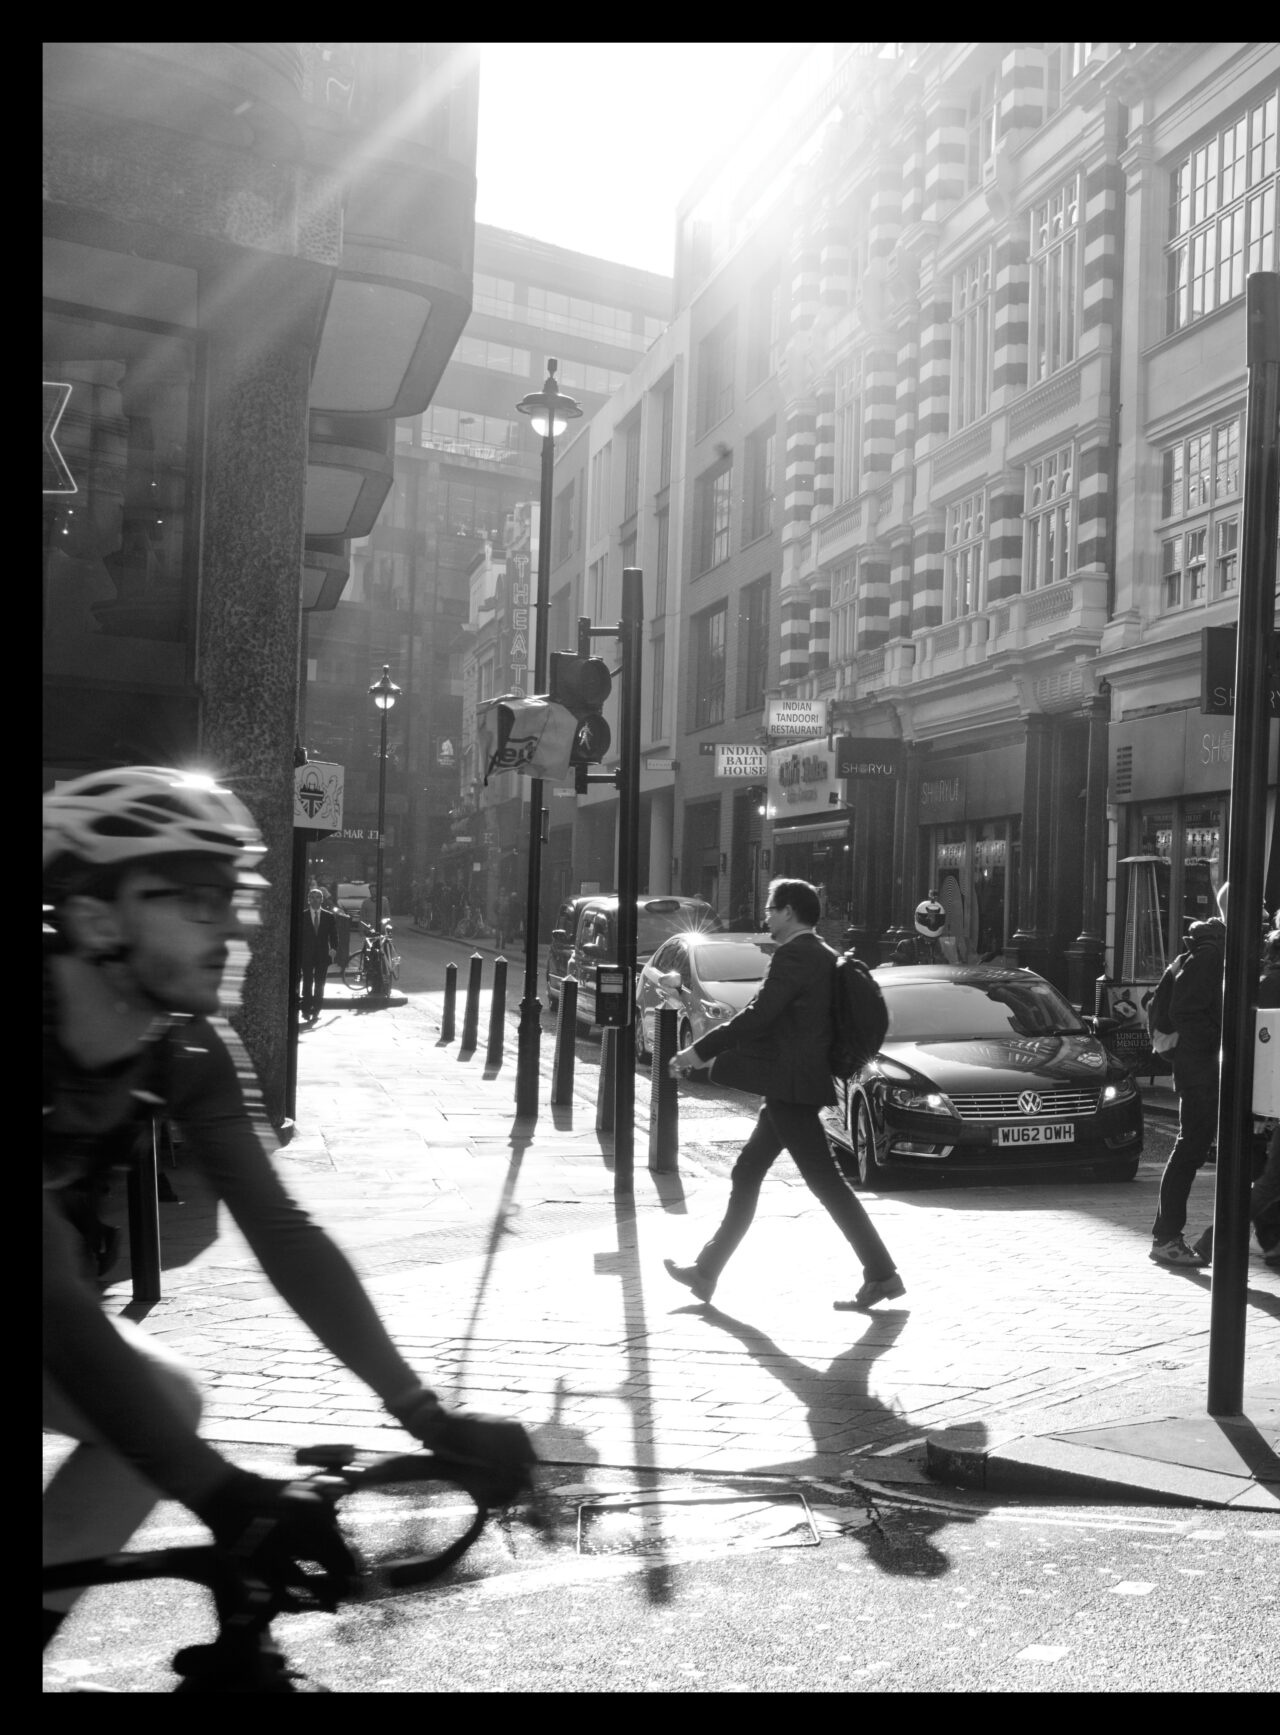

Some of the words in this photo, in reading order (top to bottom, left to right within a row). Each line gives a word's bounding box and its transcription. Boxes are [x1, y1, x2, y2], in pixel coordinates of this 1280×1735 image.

[782, 701, 812, 711] INDIAN
[776, 713, 819, 723] TANDOORI
[770, 725, 824, 735] RESTAURANT
[721, 746, 768, 756] INDIAN
[726, 756, 763, 766] BALTI
[723, 766, 767, 776] HOUSE
[1002, 1127, 1040, 1142] WU62
[1044, 1125, 1072, 1140] OWH
